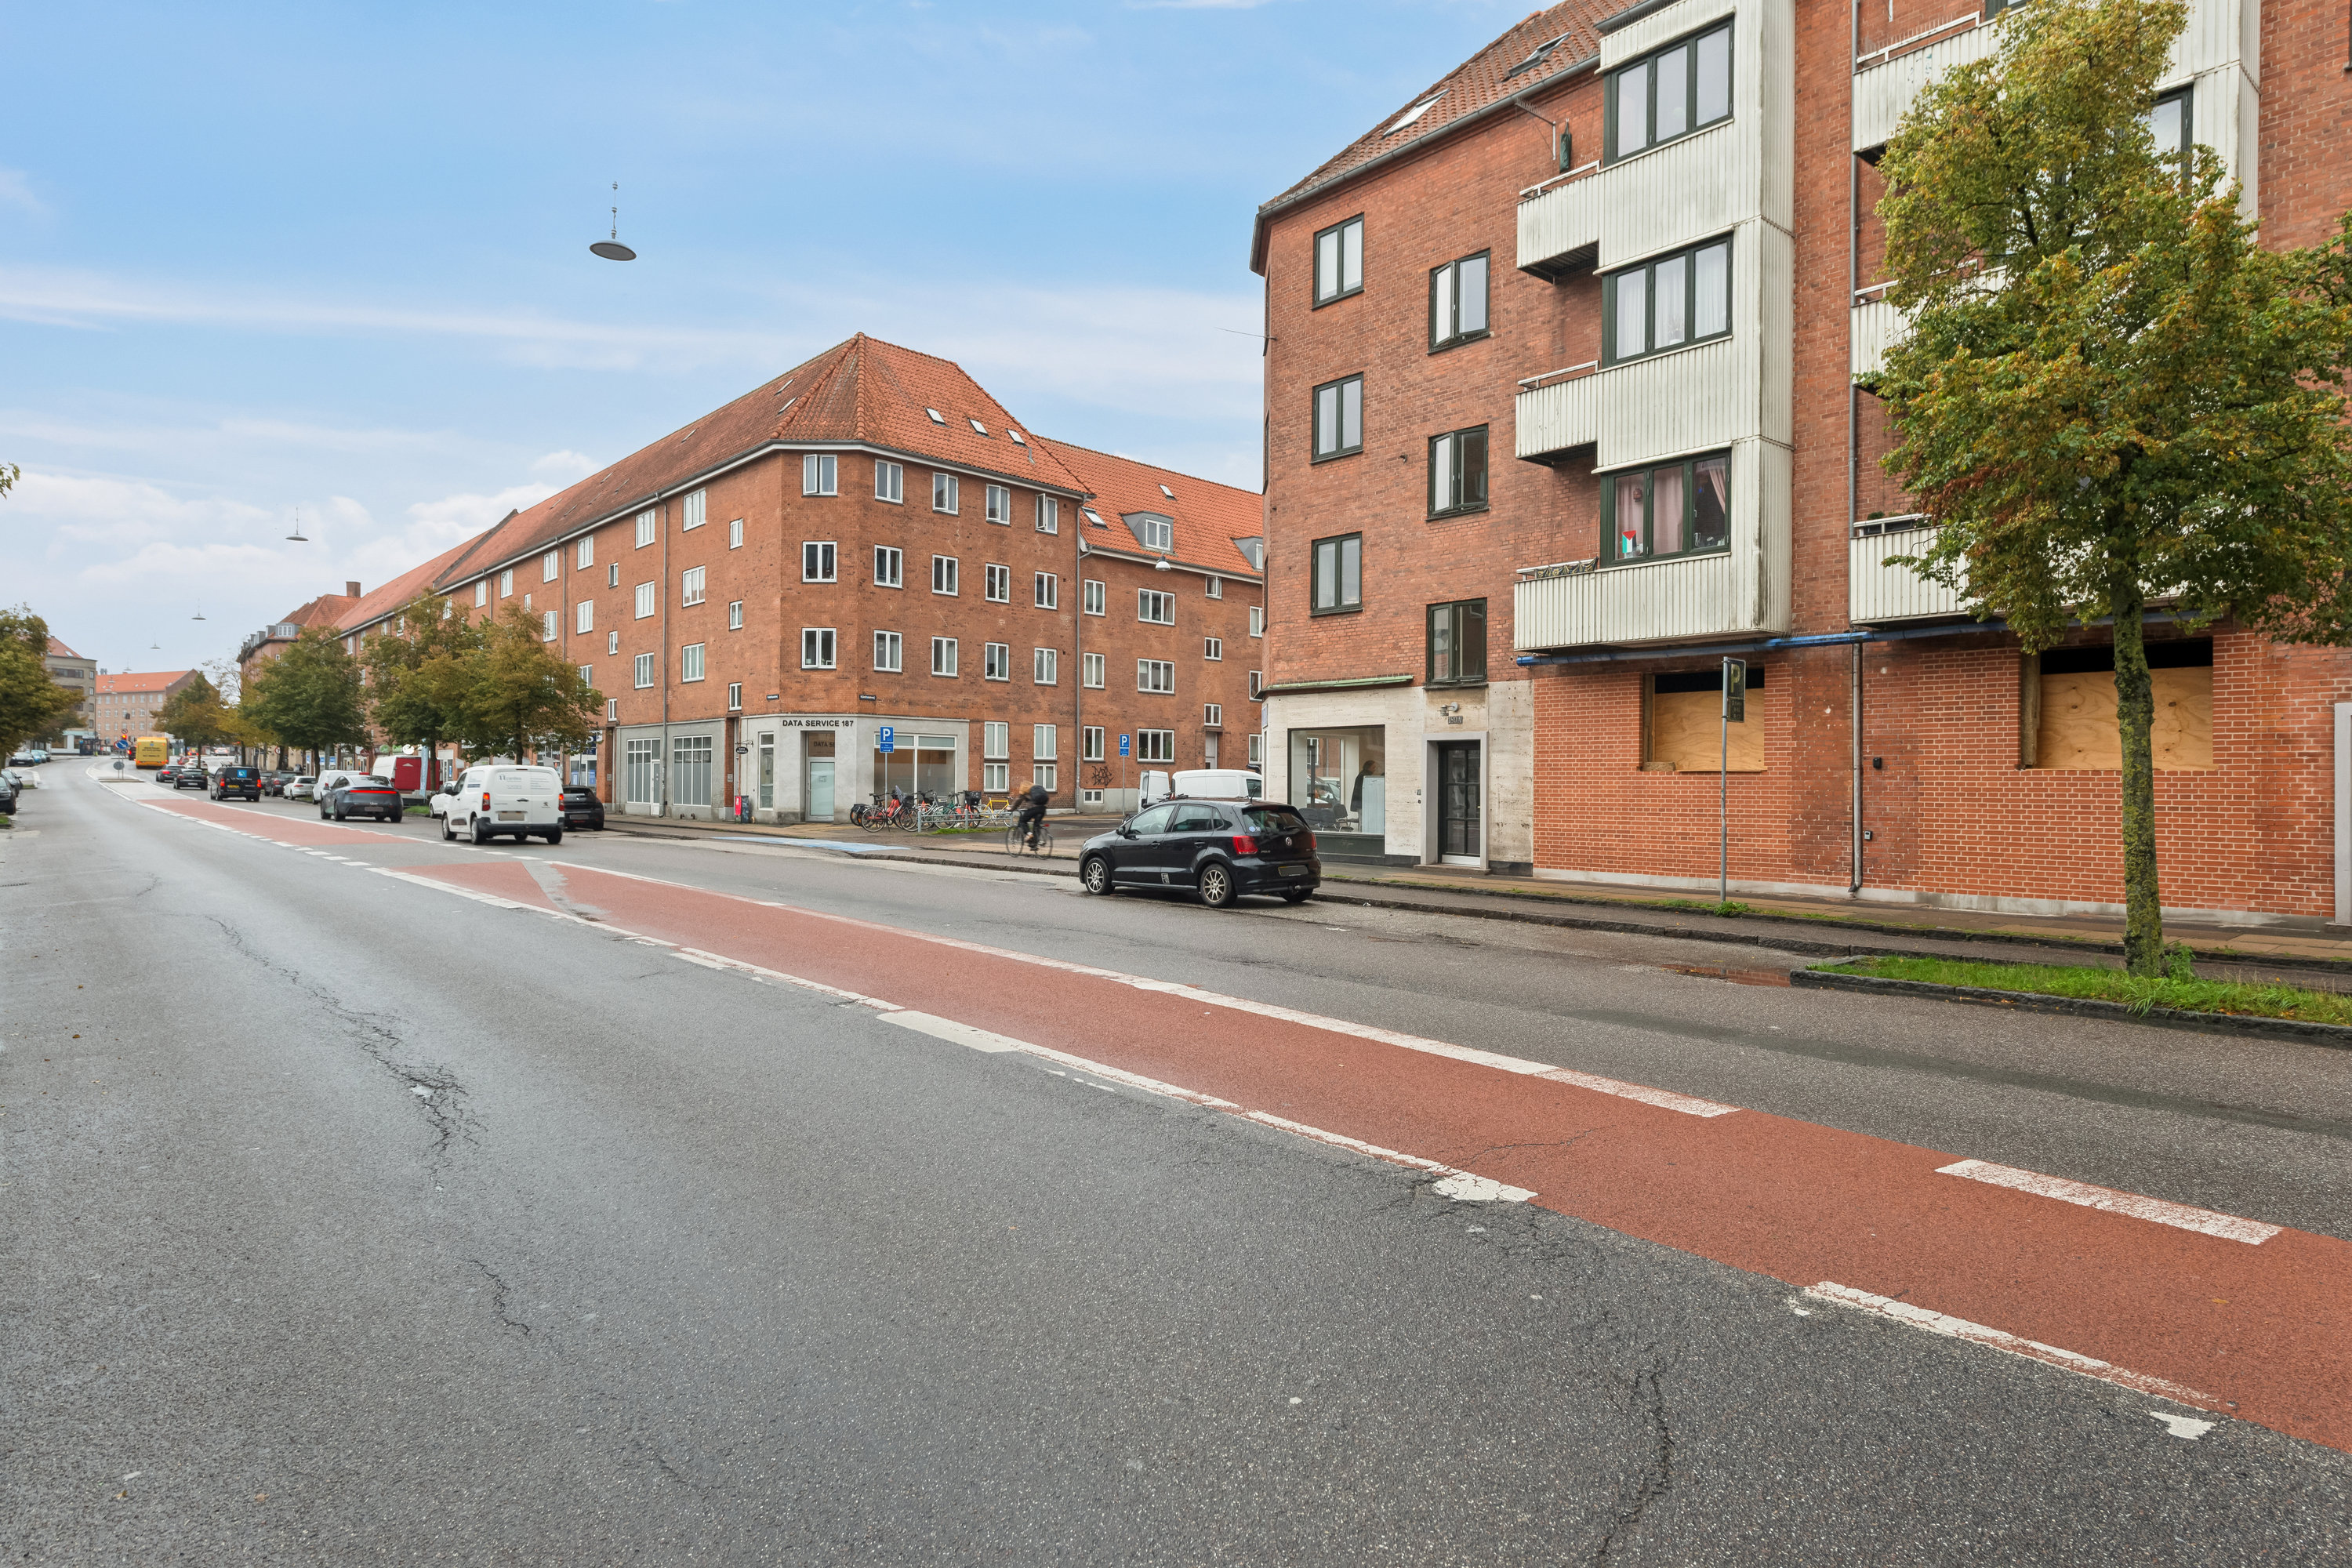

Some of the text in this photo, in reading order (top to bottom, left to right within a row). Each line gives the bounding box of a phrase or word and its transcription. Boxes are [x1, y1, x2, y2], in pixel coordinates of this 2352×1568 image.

[1730, 663, 1740, 693] P
[883, 728, 891, 741] P
[1121, 735, 1127, 746] P
